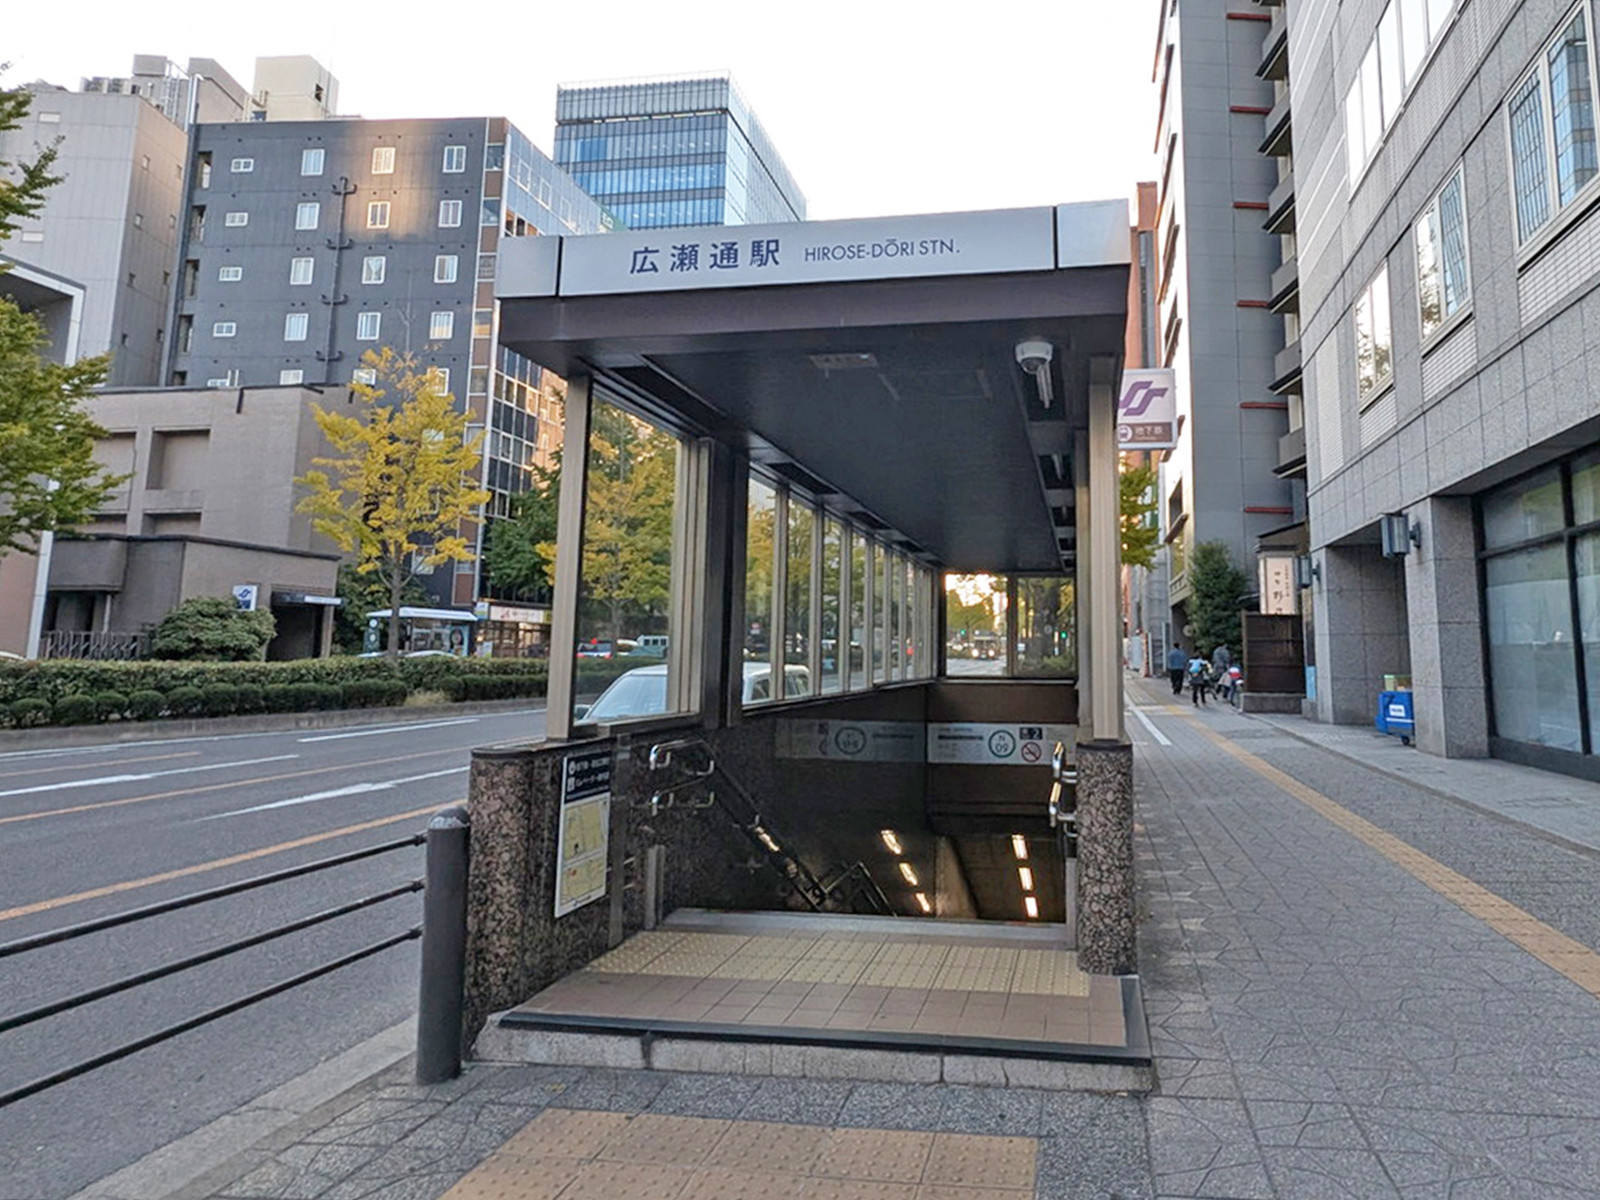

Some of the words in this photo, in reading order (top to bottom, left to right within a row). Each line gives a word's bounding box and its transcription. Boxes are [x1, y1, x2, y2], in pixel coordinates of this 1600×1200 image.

[630, 239, 780, 275] 広瀬通駅
[804, 238, 915, 262] HIROSE-DŌRI
[919, 239, 960, 256] STN.
